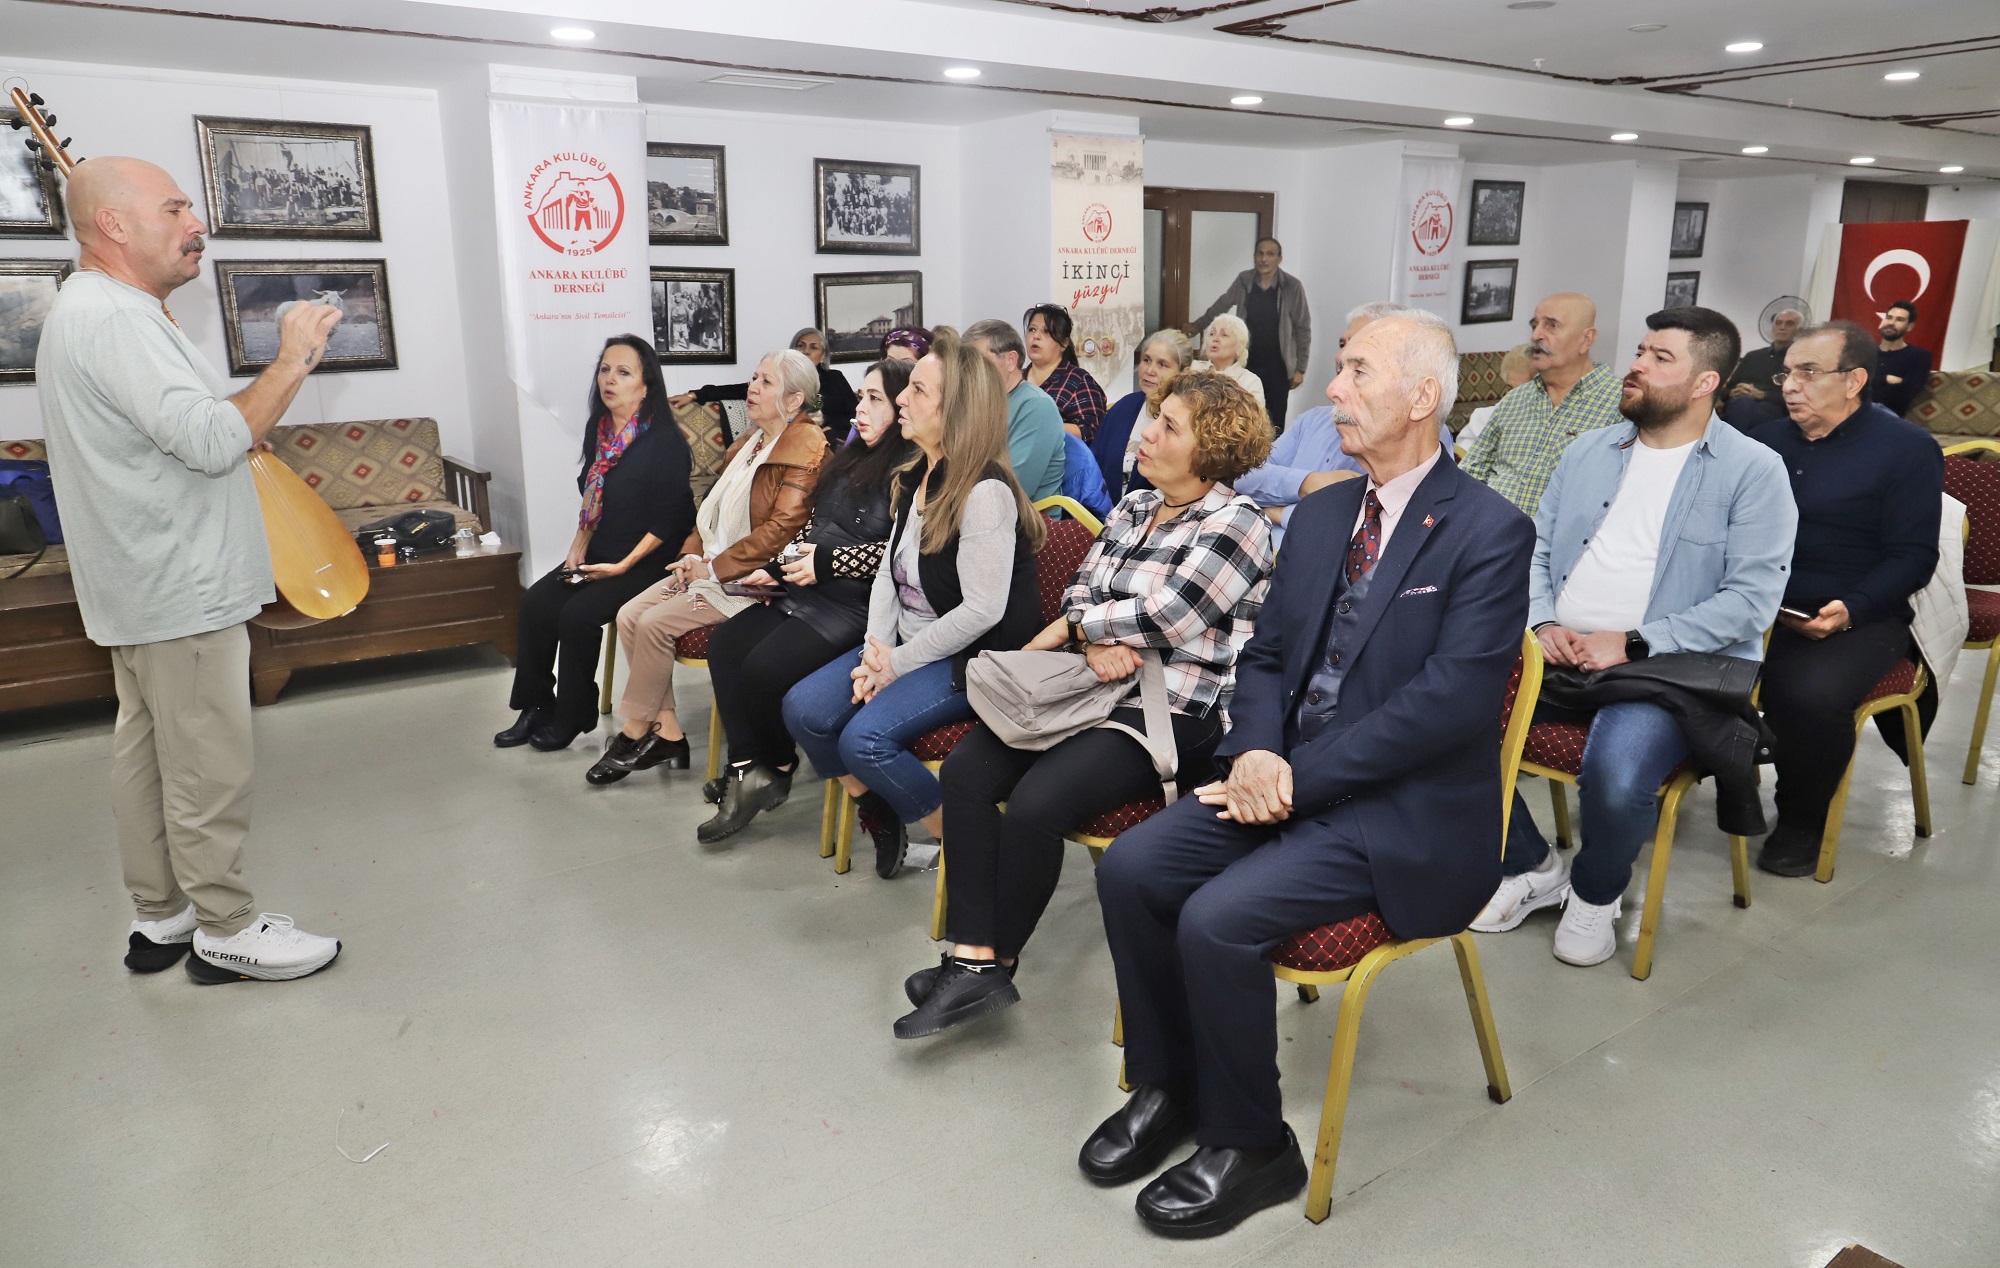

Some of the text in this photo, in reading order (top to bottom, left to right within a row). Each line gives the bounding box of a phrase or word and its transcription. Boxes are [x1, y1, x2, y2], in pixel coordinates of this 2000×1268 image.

[524, 152, 607, 209] ANKARA KULÜBÜ
[567, 248, 592, 256] 1925
[1109, 246, 1137, 254] DERNEĞİ
[529, 268, 628, 279] ANKARA KULÜBÜ
[1062, 260, 1130, 280] İKİNCİ
[554, 282, 605, 293] DERNEĞİ
[1072, 274, 1123, 309] yüzyıl
[201, 949, 260, 966] MERRELL
